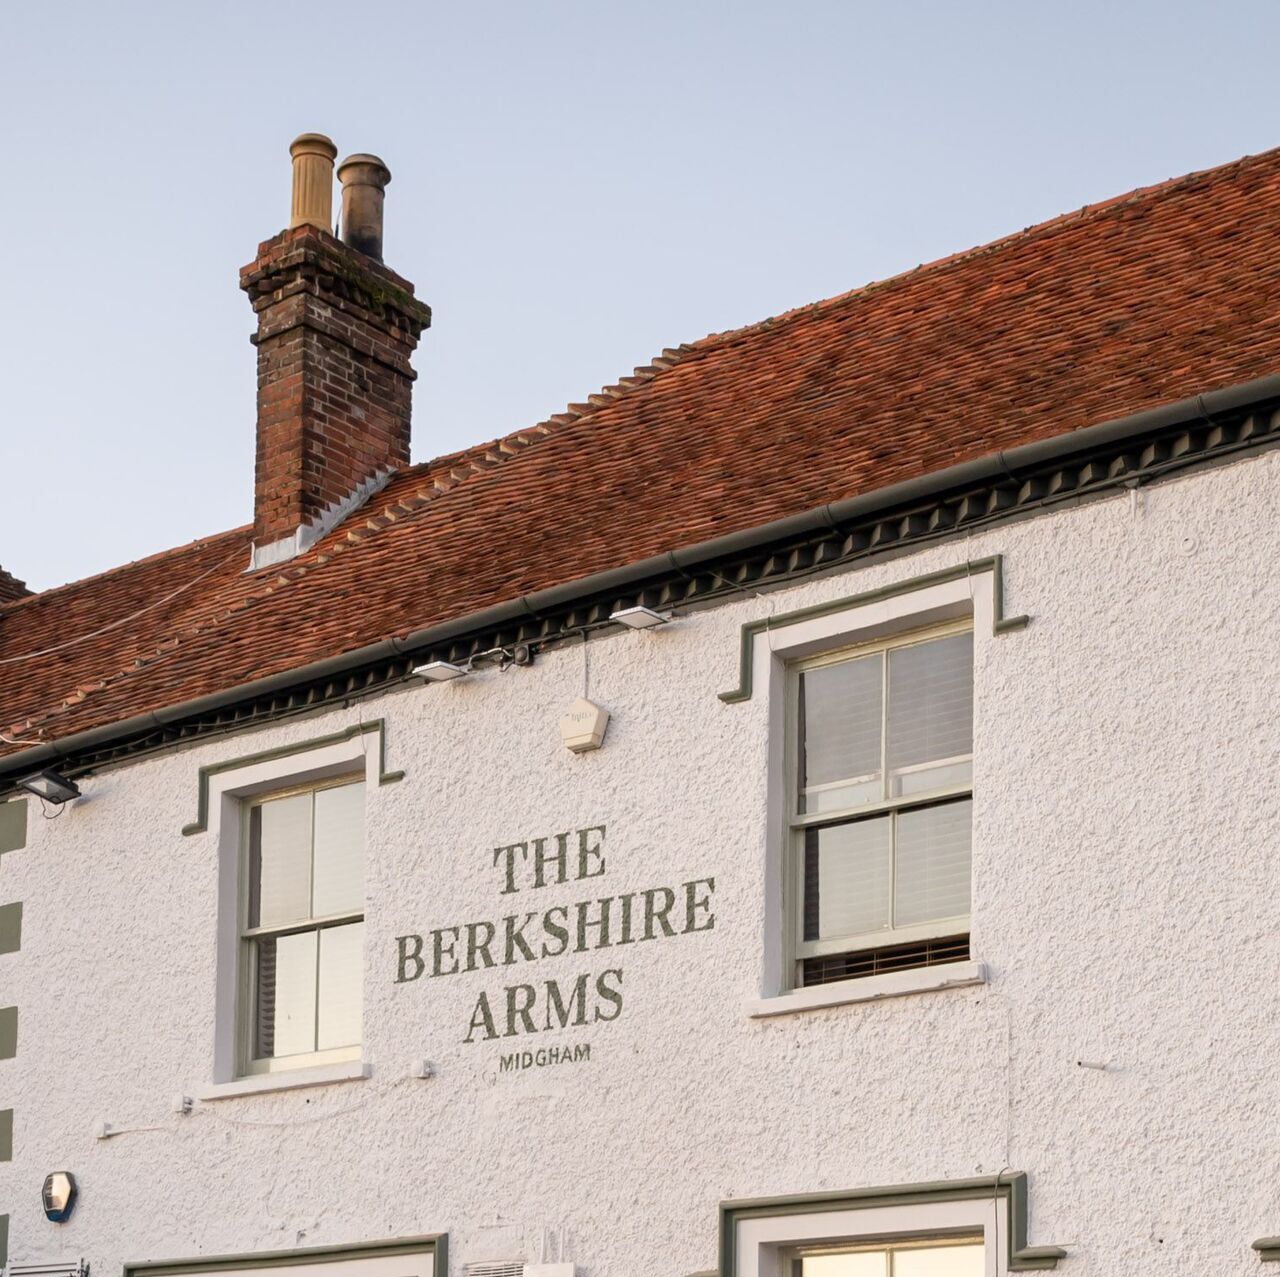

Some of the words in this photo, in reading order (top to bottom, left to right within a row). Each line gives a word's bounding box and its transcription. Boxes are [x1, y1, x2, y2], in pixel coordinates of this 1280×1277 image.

[493, 825, 607, 895] THE
[393, 877, 716, 984] BERKSHIRE
[463, 968, 624, 1043] ARMS
[499, 1043, 591, 1073] MIDGHAM
